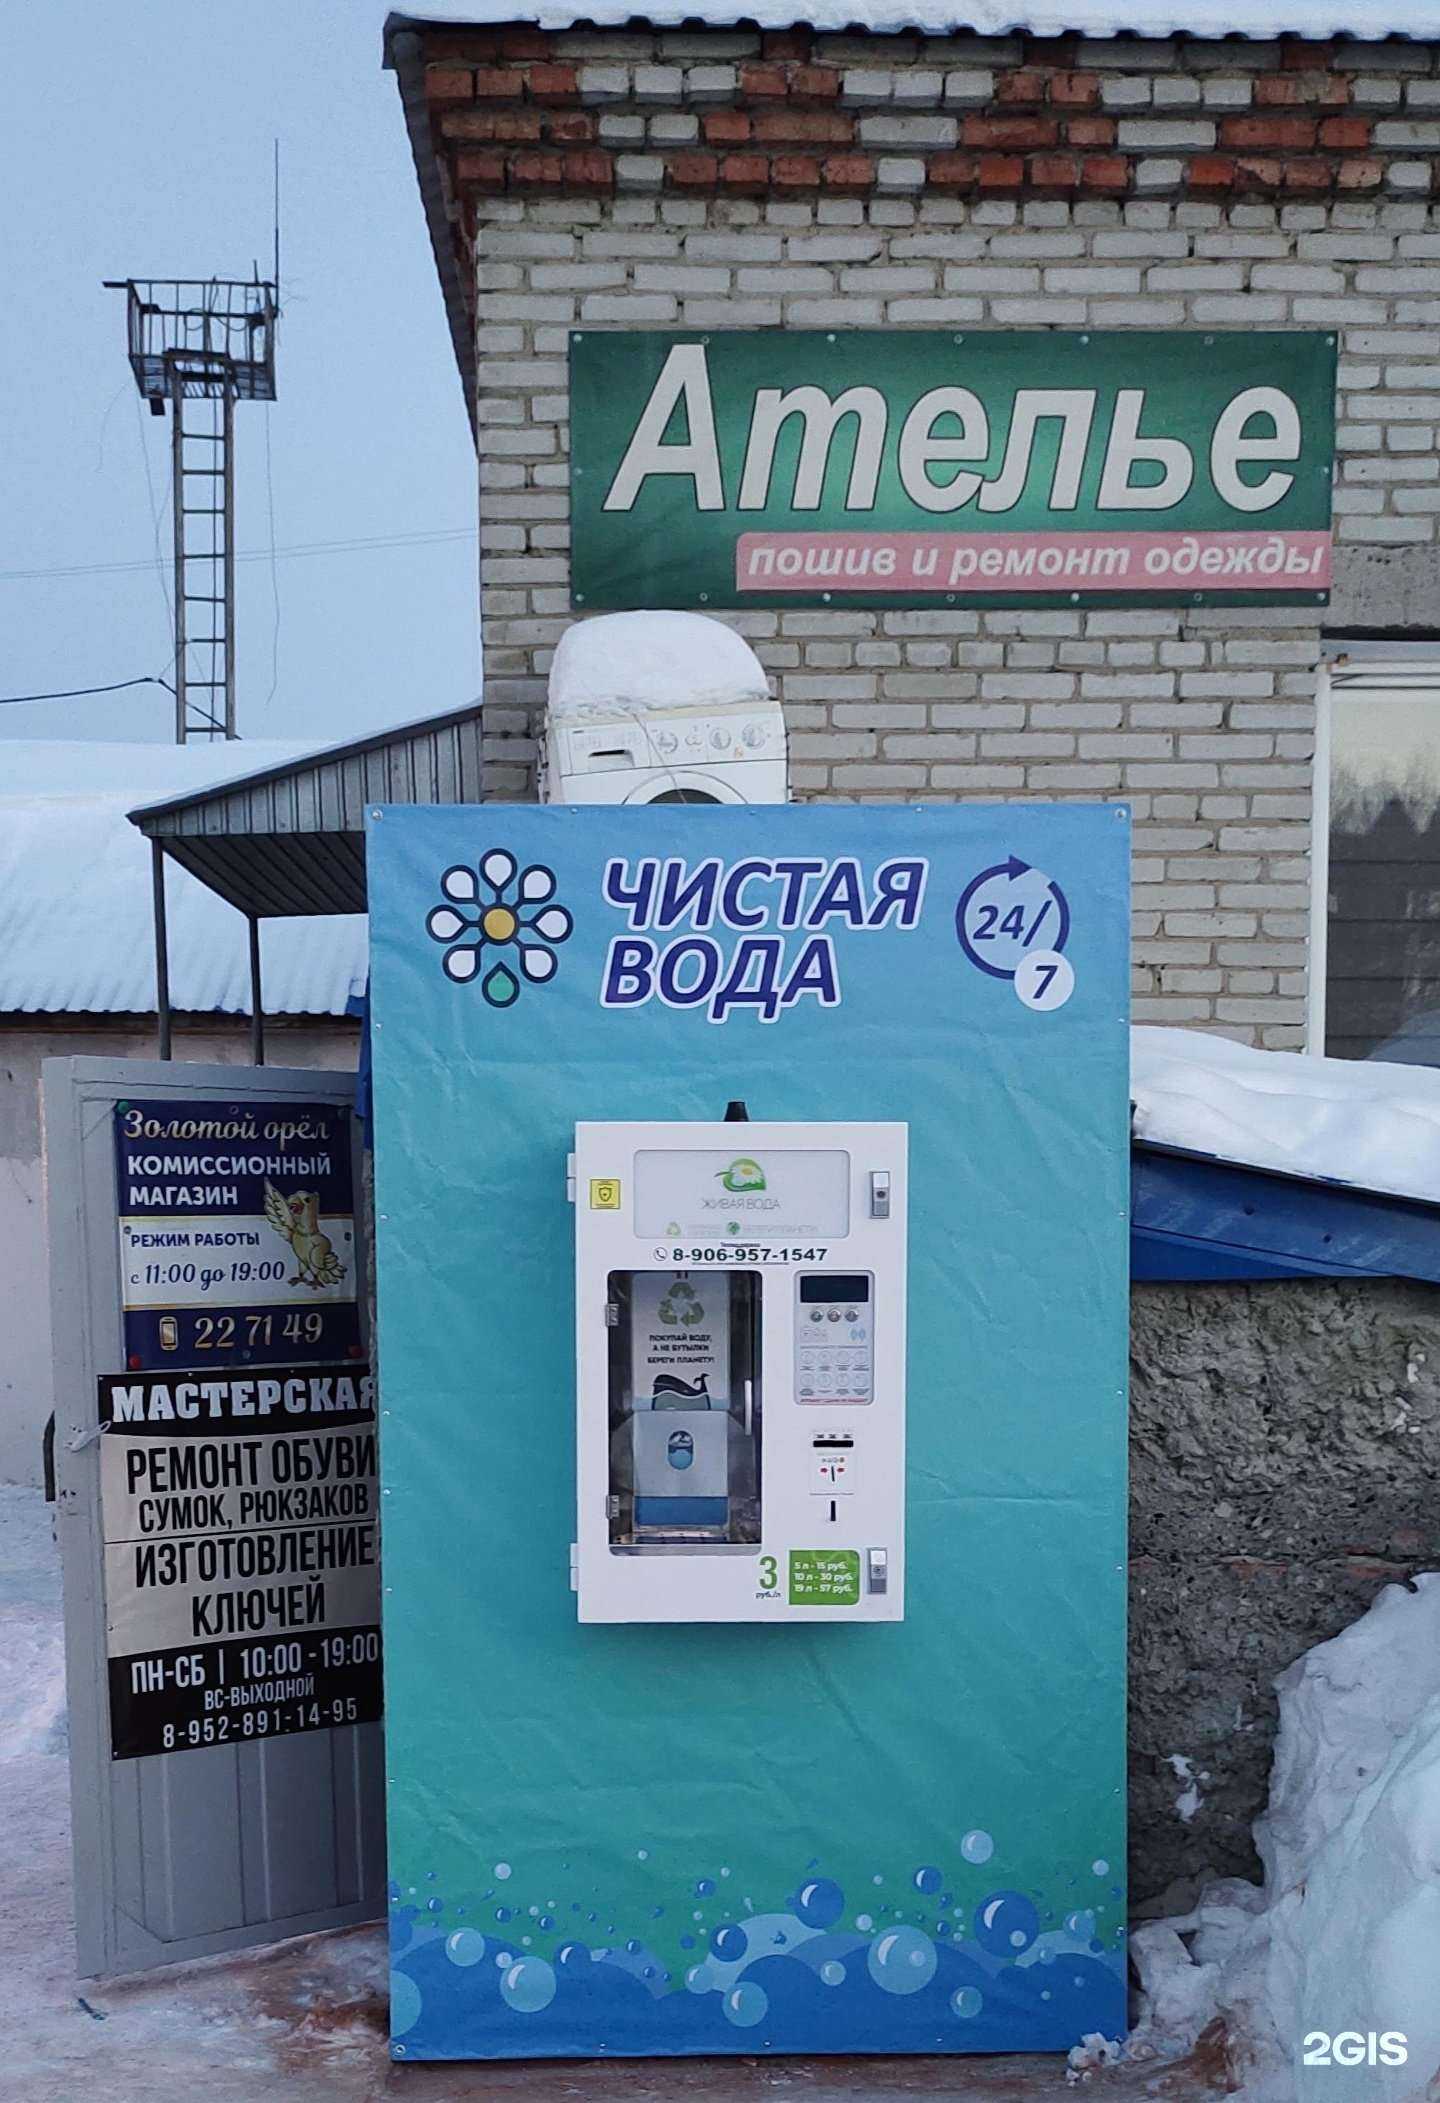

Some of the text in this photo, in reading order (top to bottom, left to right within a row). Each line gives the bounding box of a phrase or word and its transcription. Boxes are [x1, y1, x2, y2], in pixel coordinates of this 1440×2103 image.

[601, 343, 1302, 513] Ателье
[748, 538, 1325, 585] пошив и ремонт одежды
[602, 857, 929, 930] ЧИСТАЯ
[600, 935, 841, 1023] ВОДА
[123, 1109, 330, 1151] Золотой орёл
[127, 1152, 331, 1176] КОМИССИОННЫЙ
[129, 1186, 239, 1206] МАГАЗИН
[131, 1232, 260, 1248] РЕЖИМ РАБОТЫ
[673, 1248, 827, 1261] 8-906-957-1547
[130, 1261, 285, 1291] с 11:00 до 19:00
[194, 1312, 324, 1349] 22 71 49
[111, 1375, 377, 1423] МАСТЕРСКАЯ
[126, 1434, 376, 1494] РЕМОНТ ОБУВИ
[139, 1483, 369, 1532] СУМОК, РЮКЗАКОВ
[136, 1525, 375, 1588] ИЗГОТОВЛЕНИЕ
[759, 1555, 778, 1590] 3
[192, 1575, 326, 1637] КЛЮЧЕЙ
[820, 1584, 831, 1592] 57
[131, 1654, 206, 1694] ПН-СБ
[204, 1673, 316, 1711] ВС-ВЫХОДНОЙ
[163, 1697, 358, 1749] 8-952-891-14-95
